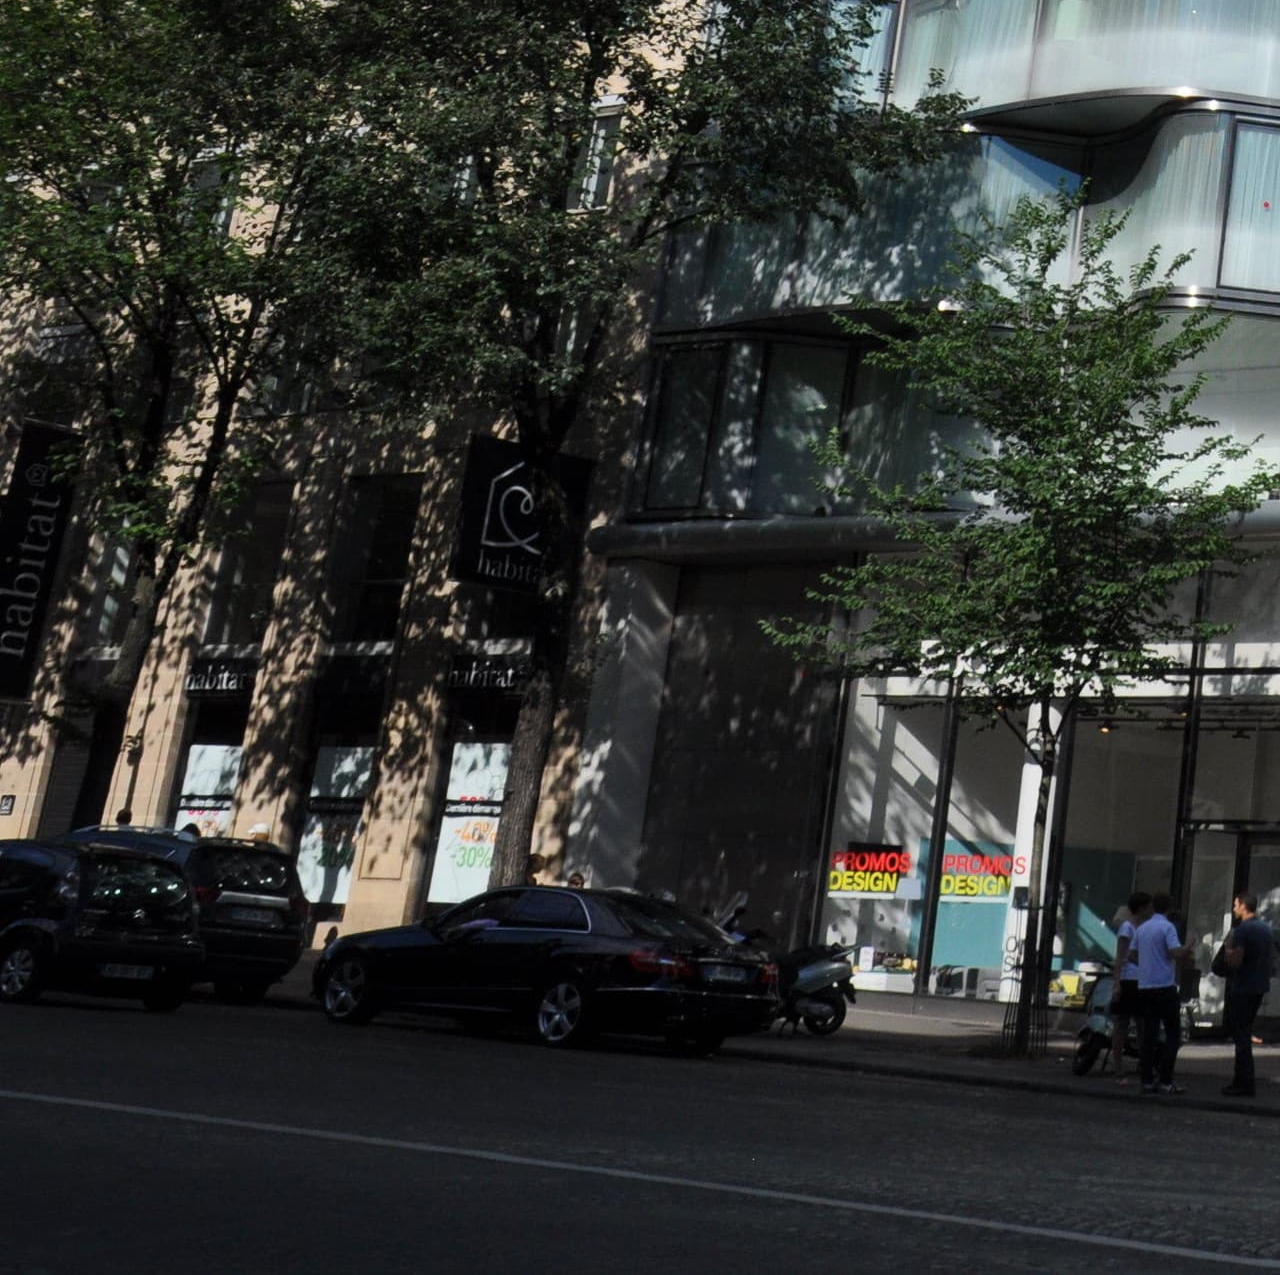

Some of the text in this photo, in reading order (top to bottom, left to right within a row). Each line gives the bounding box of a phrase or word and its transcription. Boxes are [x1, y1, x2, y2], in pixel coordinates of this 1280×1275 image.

[832, 851, 912, 875] PROMOS
[942, 853, 1026, 876] PROMOS
[827, 870, 898, 892] DESIGN
[940, 874, 1011, 896] DESIGN
